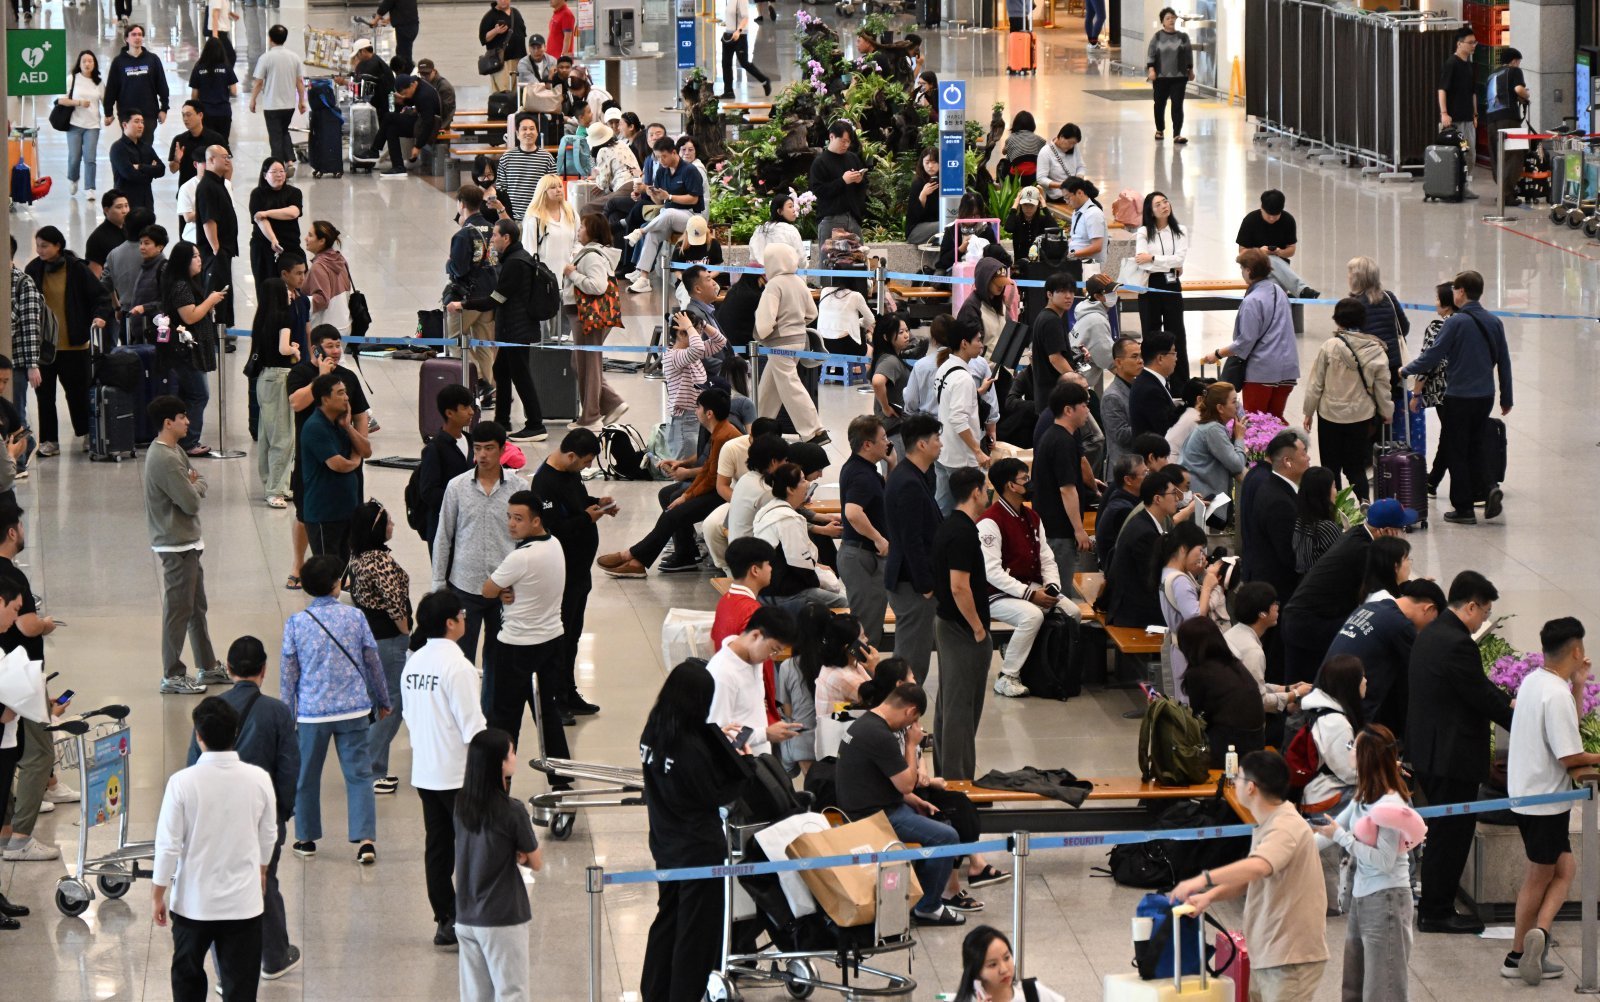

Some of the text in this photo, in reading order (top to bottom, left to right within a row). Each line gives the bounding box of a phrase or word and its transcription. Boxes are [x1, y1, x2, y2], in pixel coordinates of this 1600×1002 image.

[18, 71, 49, 84] AED
[770, 348, 797, 356] SECURITY
[406, 673, 439, 691] STAFF
[1063, 835, 1105, 847] SECURITY
[711, 865, 756, 877] SECURITY
